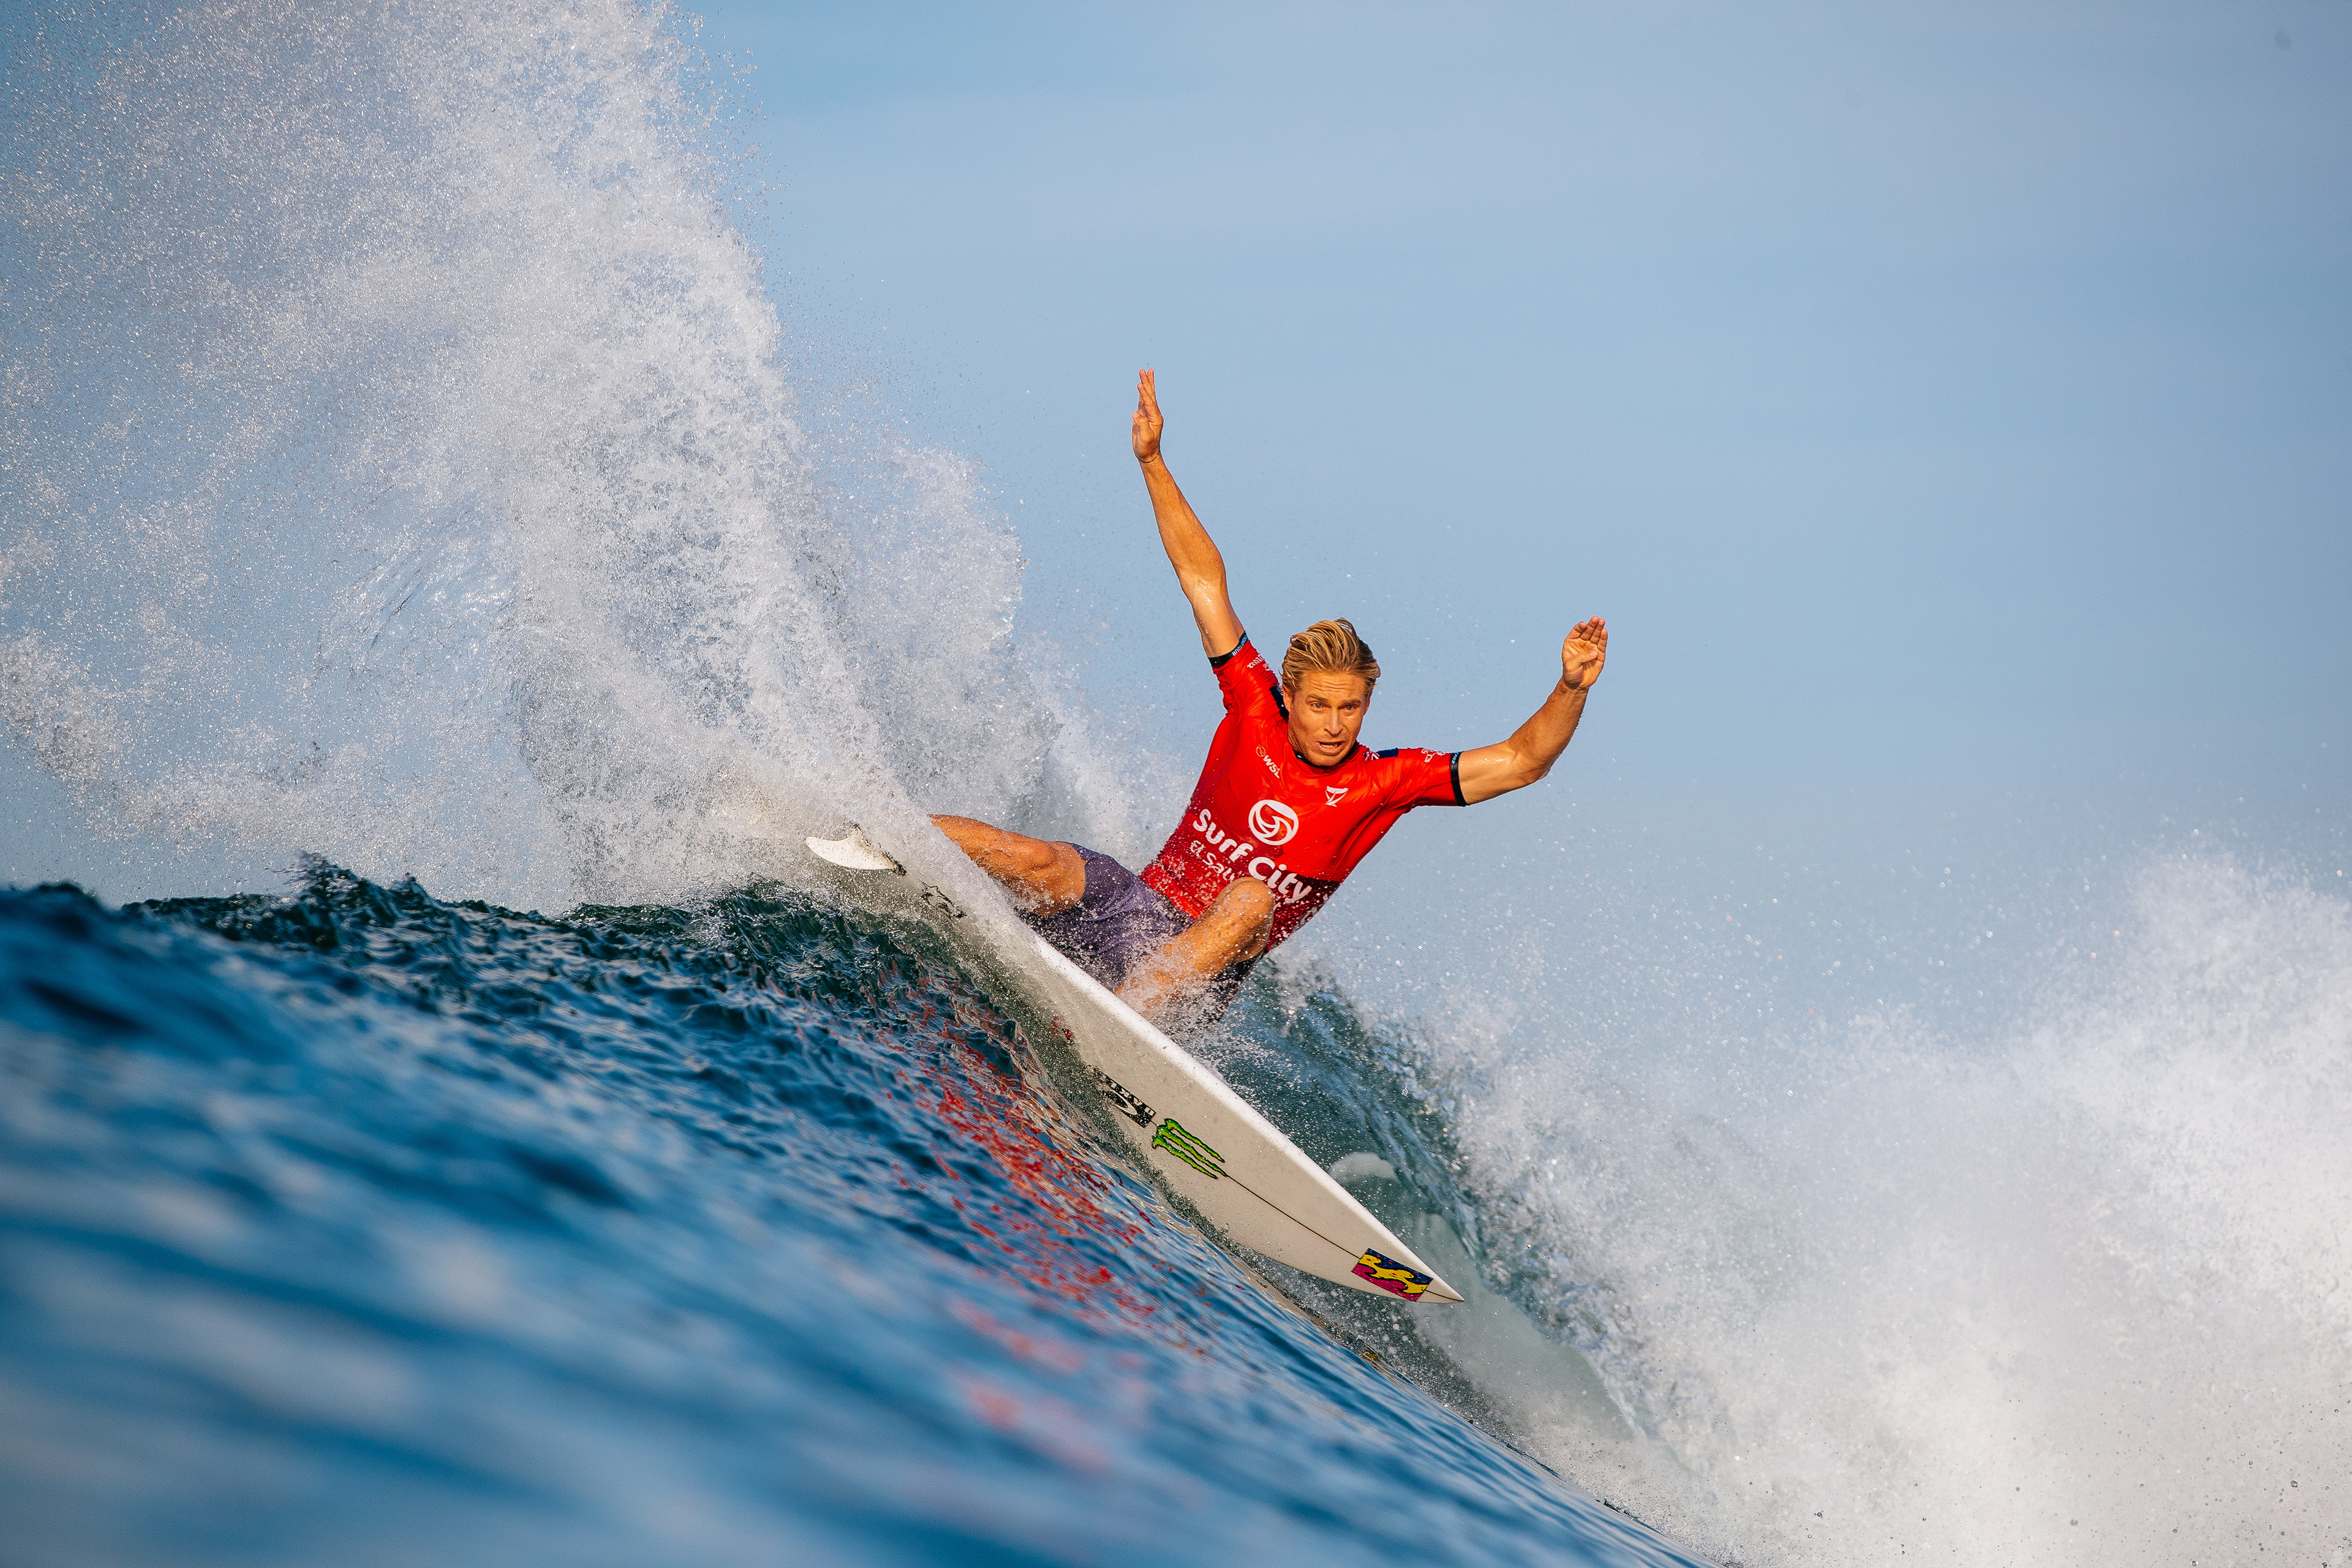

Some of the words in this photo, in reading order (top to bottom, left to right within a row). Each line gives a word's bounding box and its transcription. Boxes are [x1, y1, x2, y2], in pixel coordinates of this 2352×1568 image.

[1263, 755, 1280, 778] WSL
[1193, 809, 1254, 862] Surf
[1248, 857, 1312, 904] City
